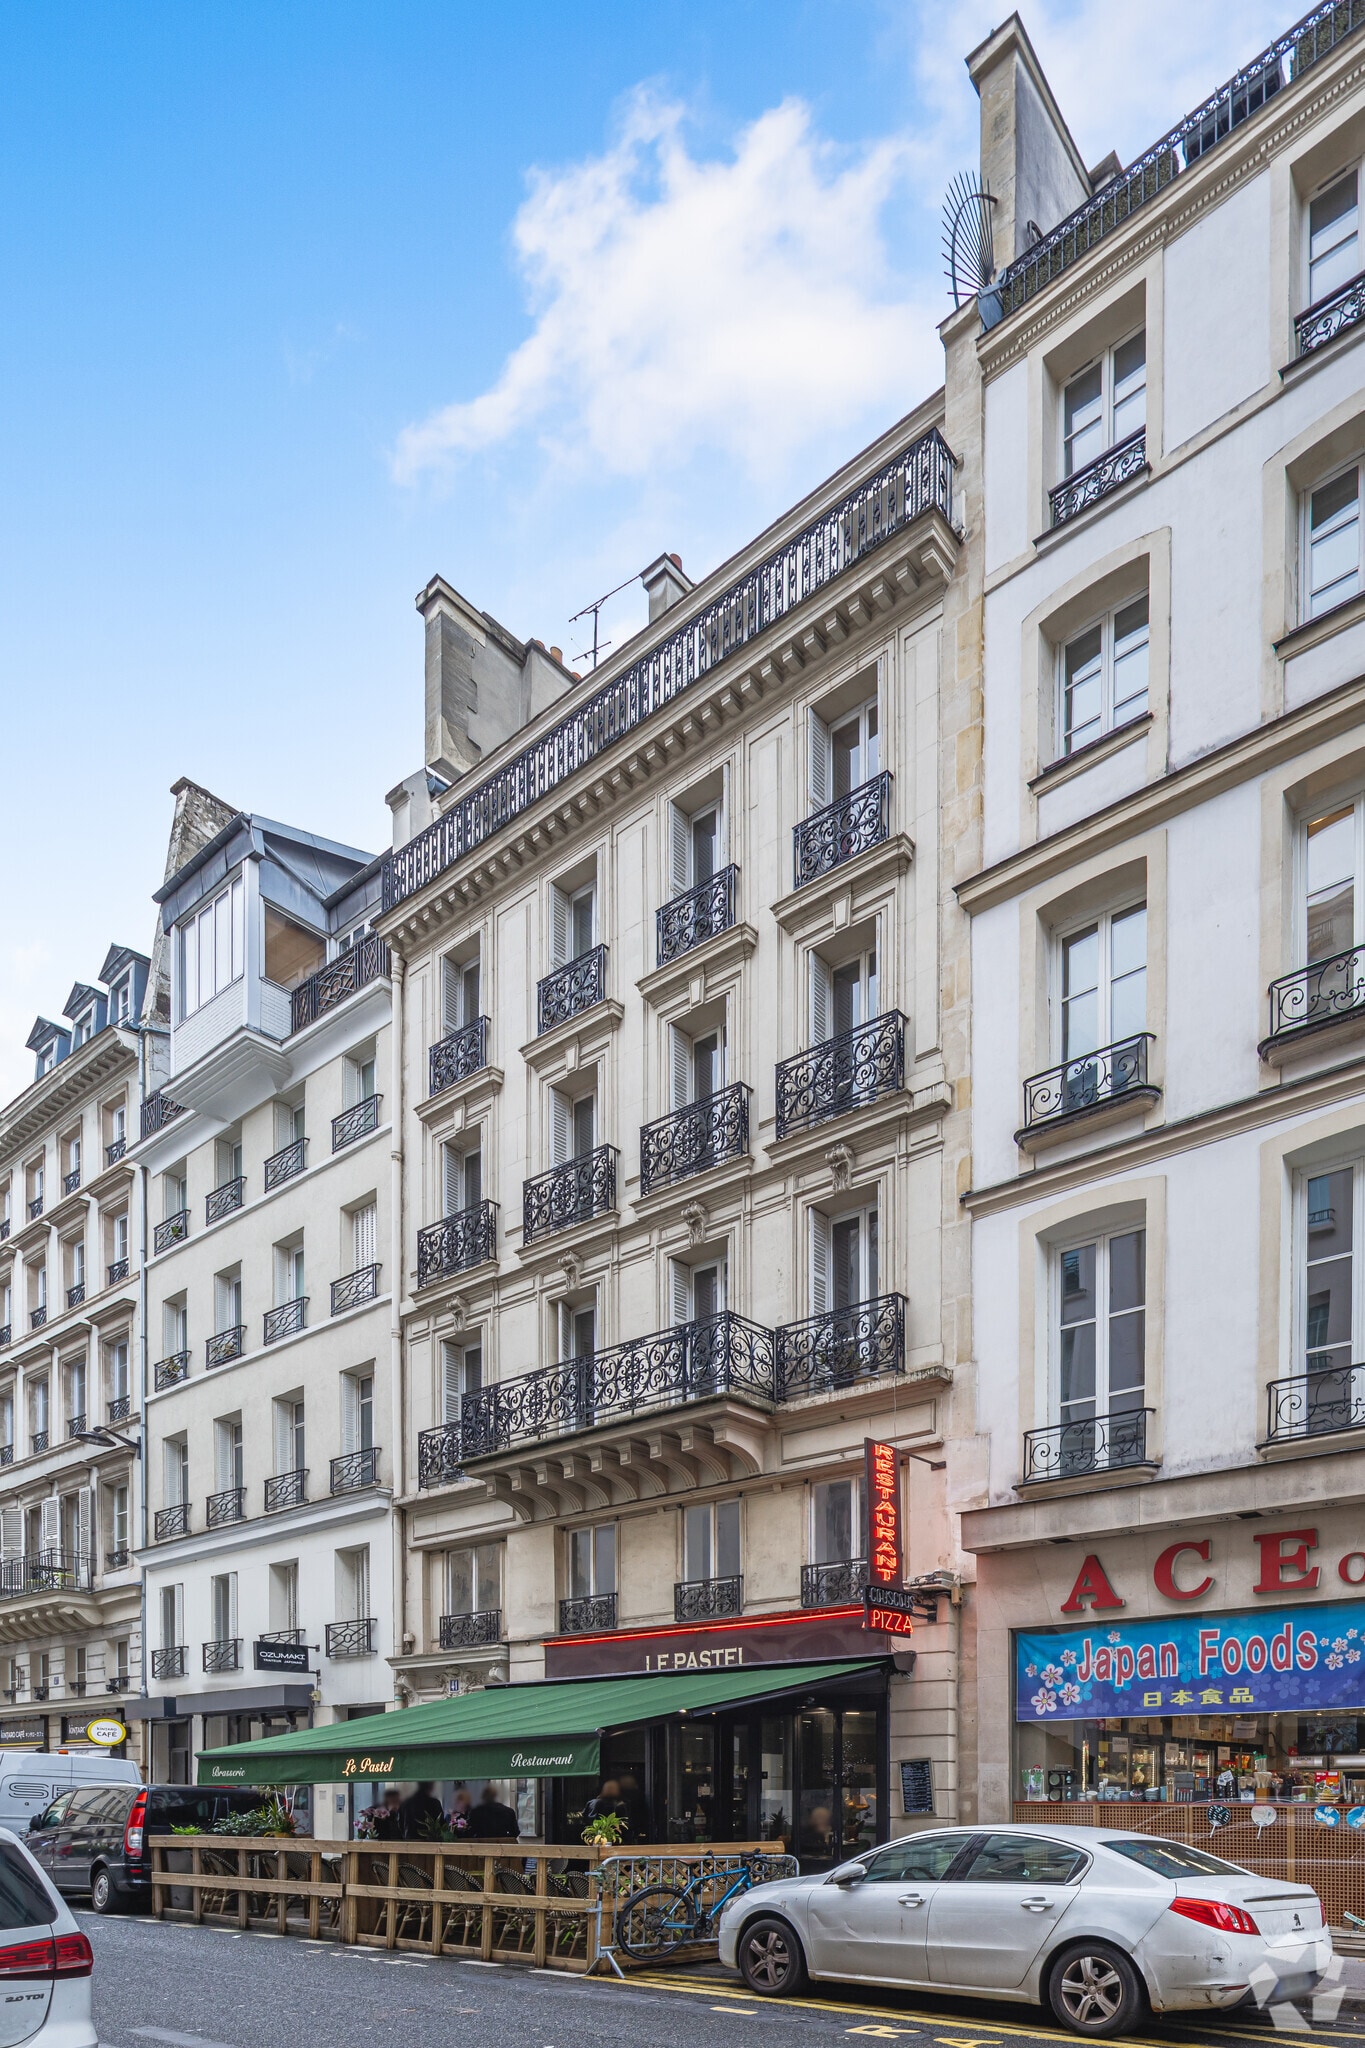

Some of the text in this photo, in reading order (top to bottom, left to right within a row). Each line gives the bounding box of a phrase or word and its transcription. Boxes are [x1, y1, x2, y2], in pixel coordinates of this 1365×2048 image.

[874, 1443, 897, 1582] RESTAURANT
[1060, 1527, 1322, 1613] ACE
[868, 1586, 915, 1610] COUSCOUS
[871, 1609, 915, 1633] PIZZA
[259, 1650, 306, 1661] OZUMAKI
[645, 1647, 743, 1672] LE PASTEL
[1076, 1622, 1319, 1687] Japan Foods
[1143, 1687, 1254, 1707] 日本食品
[211, 1765, 246, 1777] Brasserie
[341, 1757, 395, 1777] Le Pastel
[510, 1752, 574, 1768] Restaurant
[25, 1993, 45, 2001] TDI
